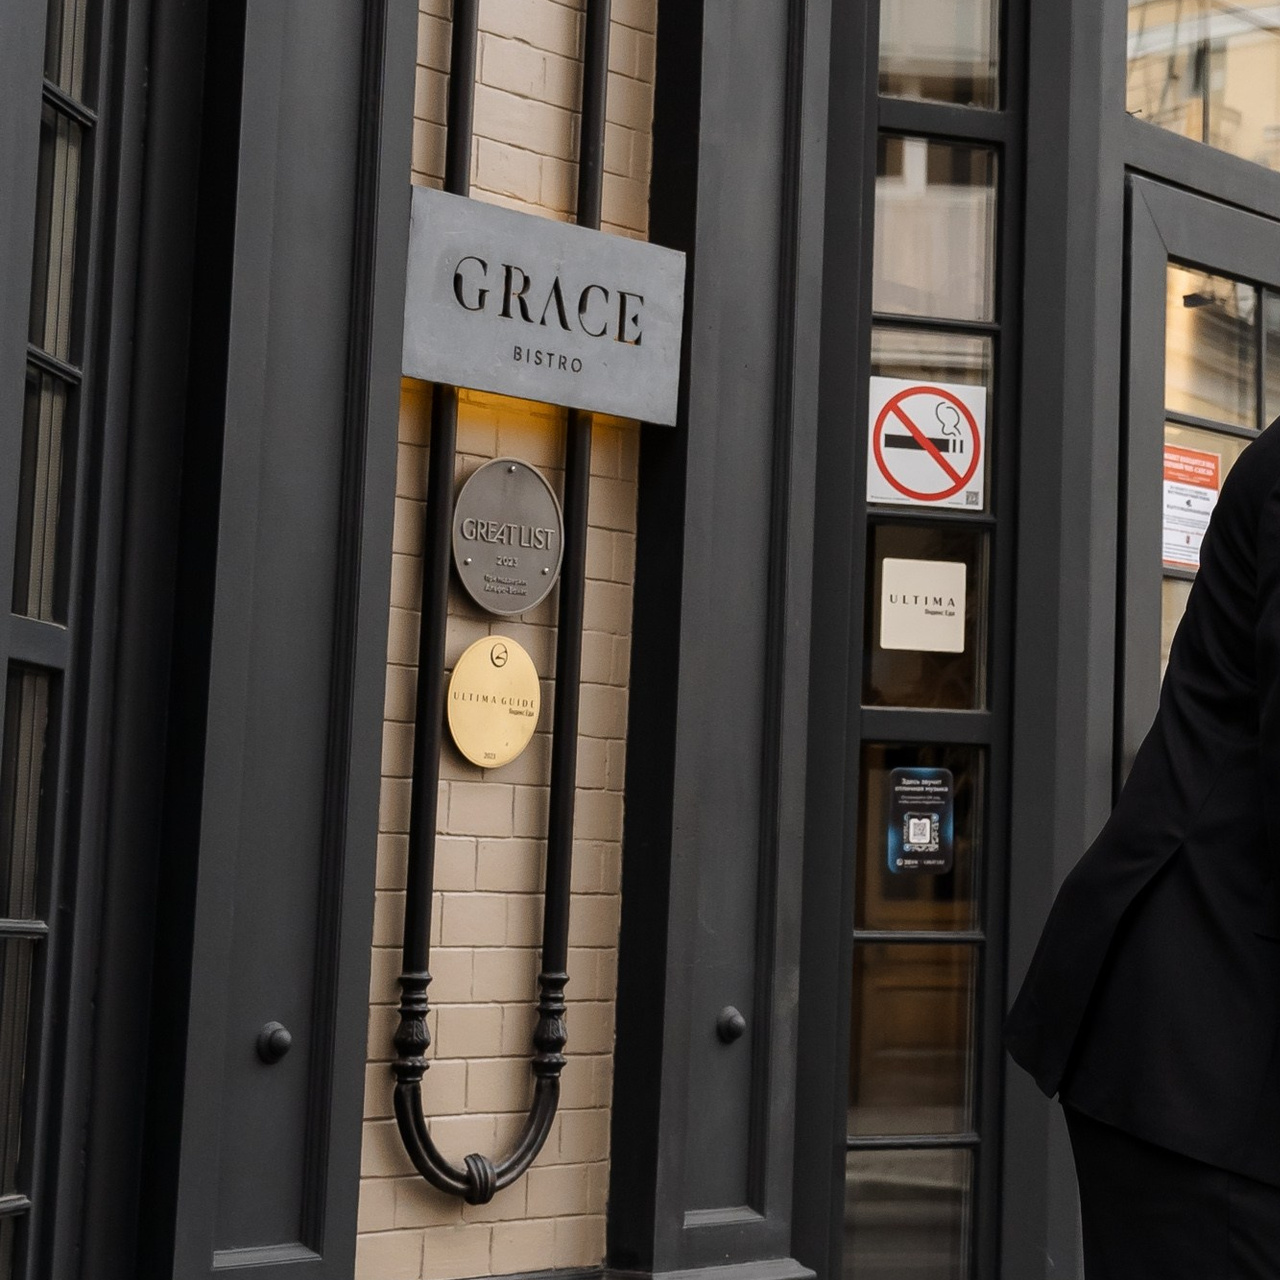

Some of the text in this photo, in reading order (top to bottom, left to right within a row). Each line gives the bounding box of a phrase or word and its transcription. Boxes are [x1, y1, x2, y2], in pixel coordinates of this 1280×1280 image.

[452, 255, 645, 347] GRACE
[513, 345, 583, 374] BISTRO
[461, 517, 555, 551] GREAT LIST
[495, 555, 519, 568] 2023
[889, 594, 955, 607] ULTIMA
[453, 691, 535, 709] ULTIMA GUIDE
